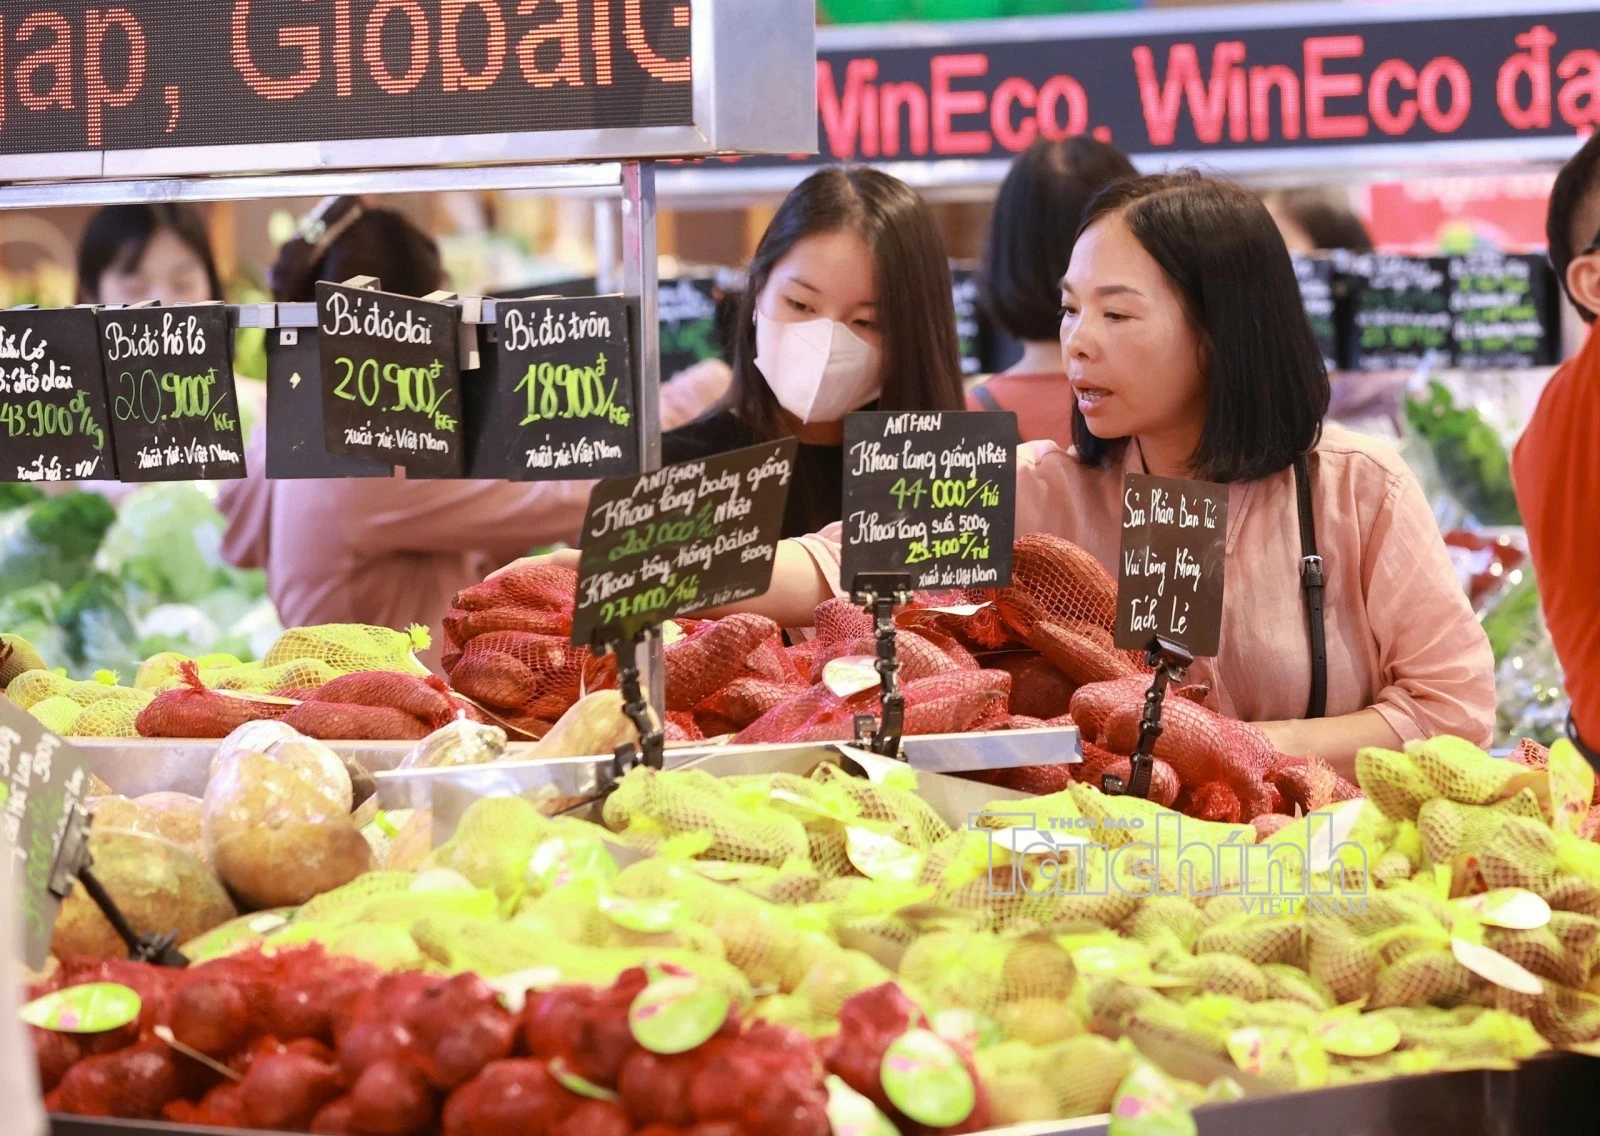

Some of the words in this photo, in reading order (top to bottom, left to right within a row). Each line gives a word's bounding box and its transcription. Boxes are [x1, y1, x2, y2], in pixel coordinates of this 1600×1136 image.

[0, 8, 180, 146] ap,
[1133, 36, 1471, 145] WinEco
[850, 440, 899, 476] Khoai
[591, 497, 656, 538] Khoai
[698, 470, 742, 500] baby
[1178, 494, 1199, 529] Bán
[1203, 498, 1219, 529] Túi
[849, 510, 895, 545] Khoai
[959, 514, 990, 537] 500g
[578, 569, 636, 609] Khoai
[1124, 549, 1141, 577] Vui
[1173, 547, 1202, 593] Không
[1130, 595, 1159, 632] Tách
